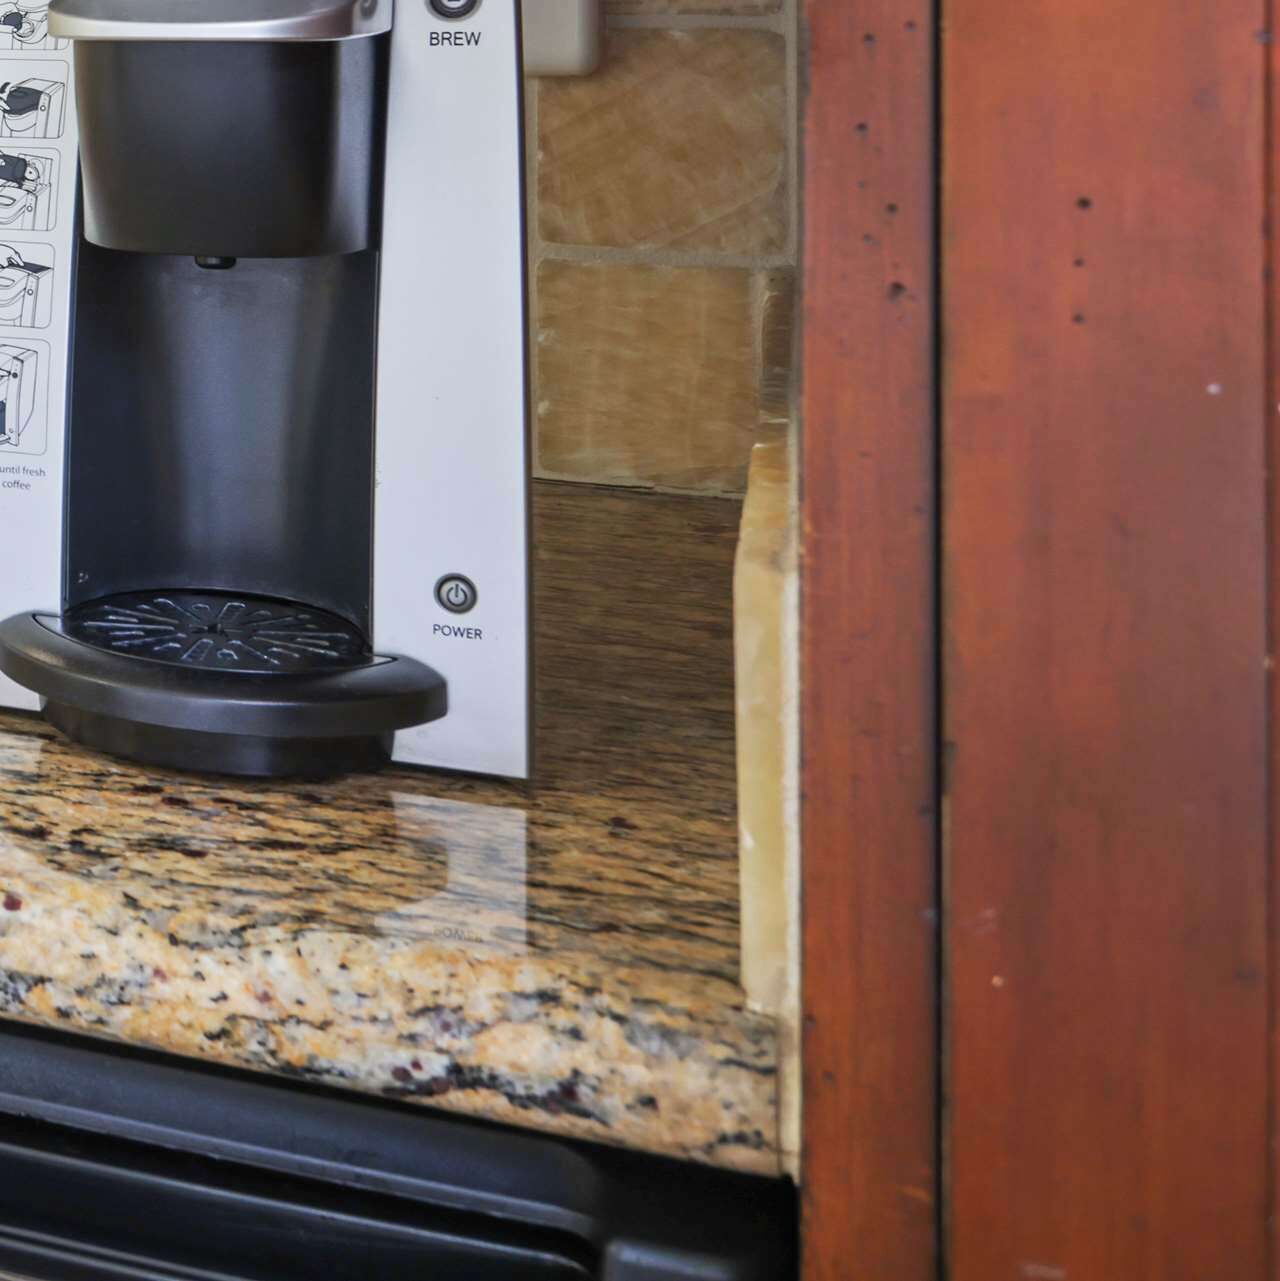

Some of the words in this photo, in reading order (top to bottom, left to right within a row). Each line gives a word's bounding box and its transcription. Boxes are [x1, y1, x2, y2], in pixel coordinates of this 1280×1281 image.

[428, 31, 482, 47] BREW
[0, 466, 20, 474] until
[22, 468, 46, 477] fresh
[2, 479, 31, 490] coffee
[432, 623, 483, 640] POWER
